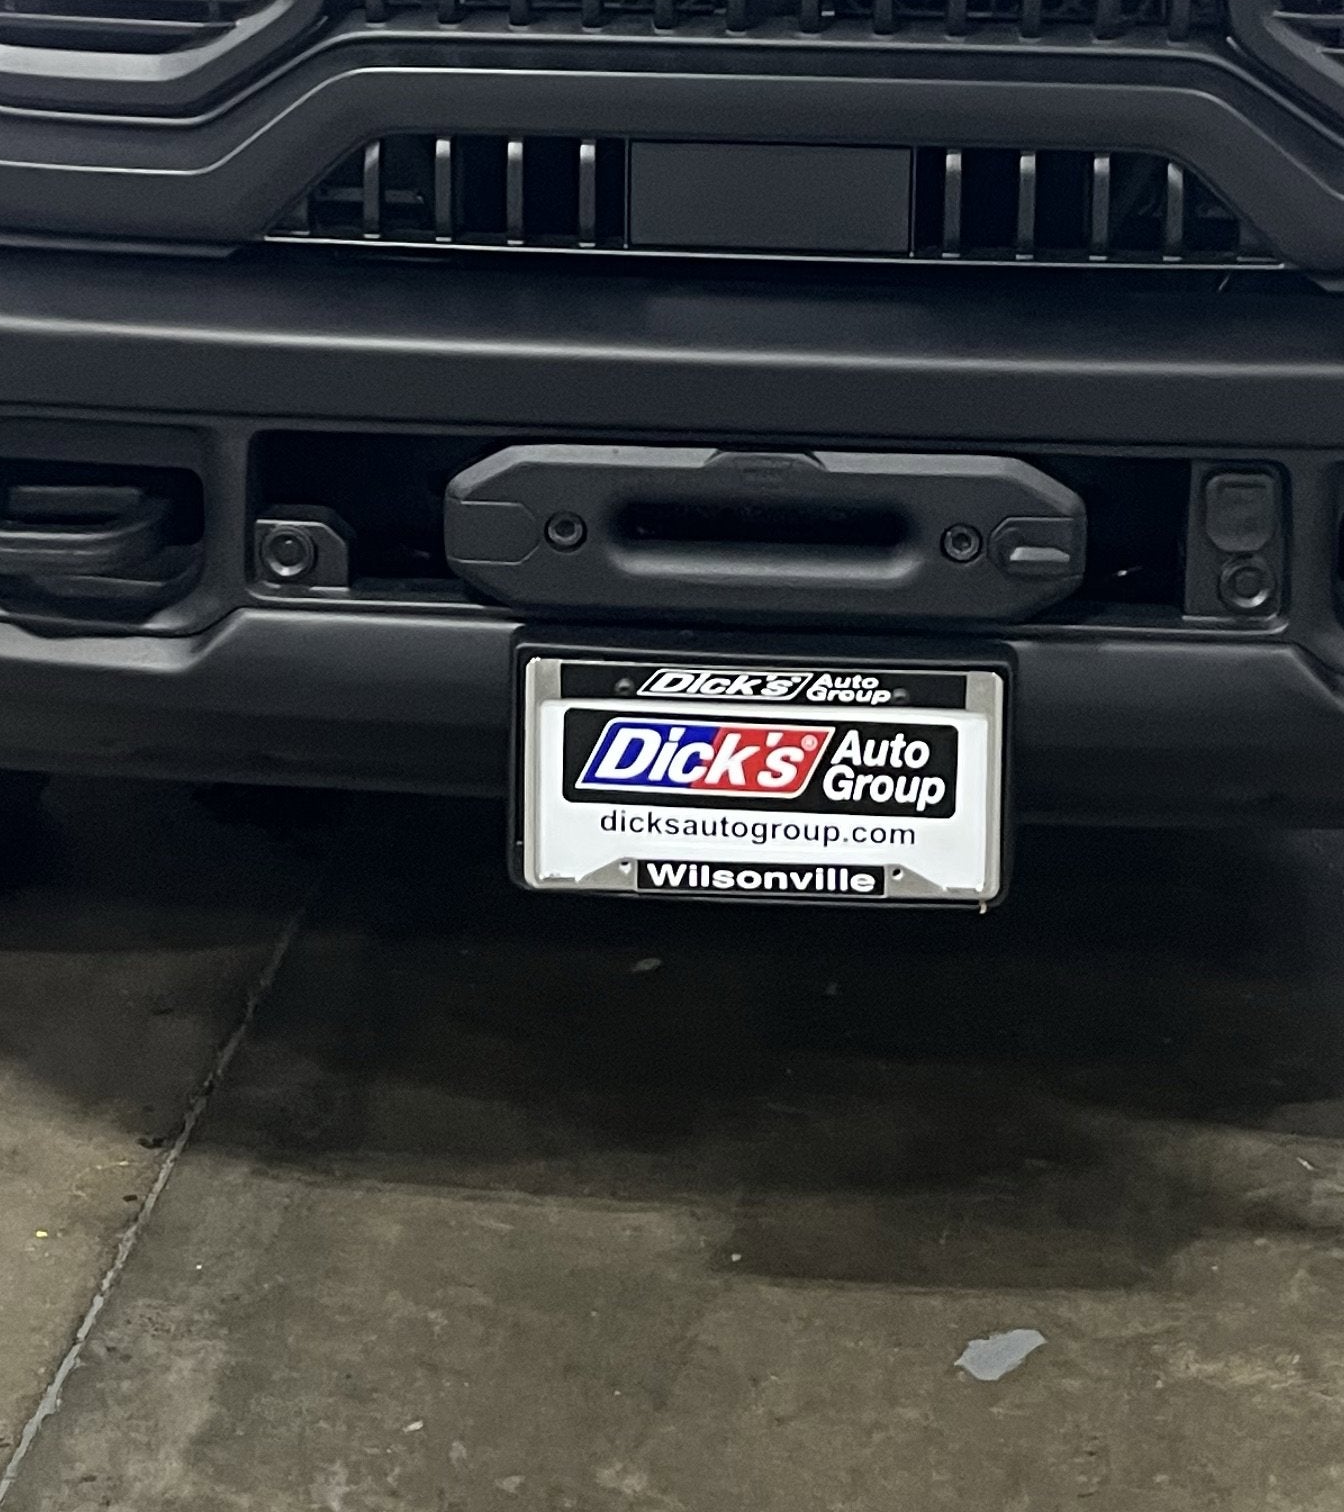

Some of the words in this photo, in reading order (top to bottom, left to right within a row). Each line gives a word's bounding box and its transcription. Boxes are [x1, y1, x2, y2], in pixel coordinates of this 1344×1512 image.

[806, 686, 892, 705] Group
[813, 673, 879, 690] Auto
[595, 726, 805, 788] Dick's
[831, 729, 930, 769] Auto
[822, 766, 946, 811] Group
[600, 810, 916, 847] dicksautogroup.com
[646, 863, 876, 892] Wilsonville
